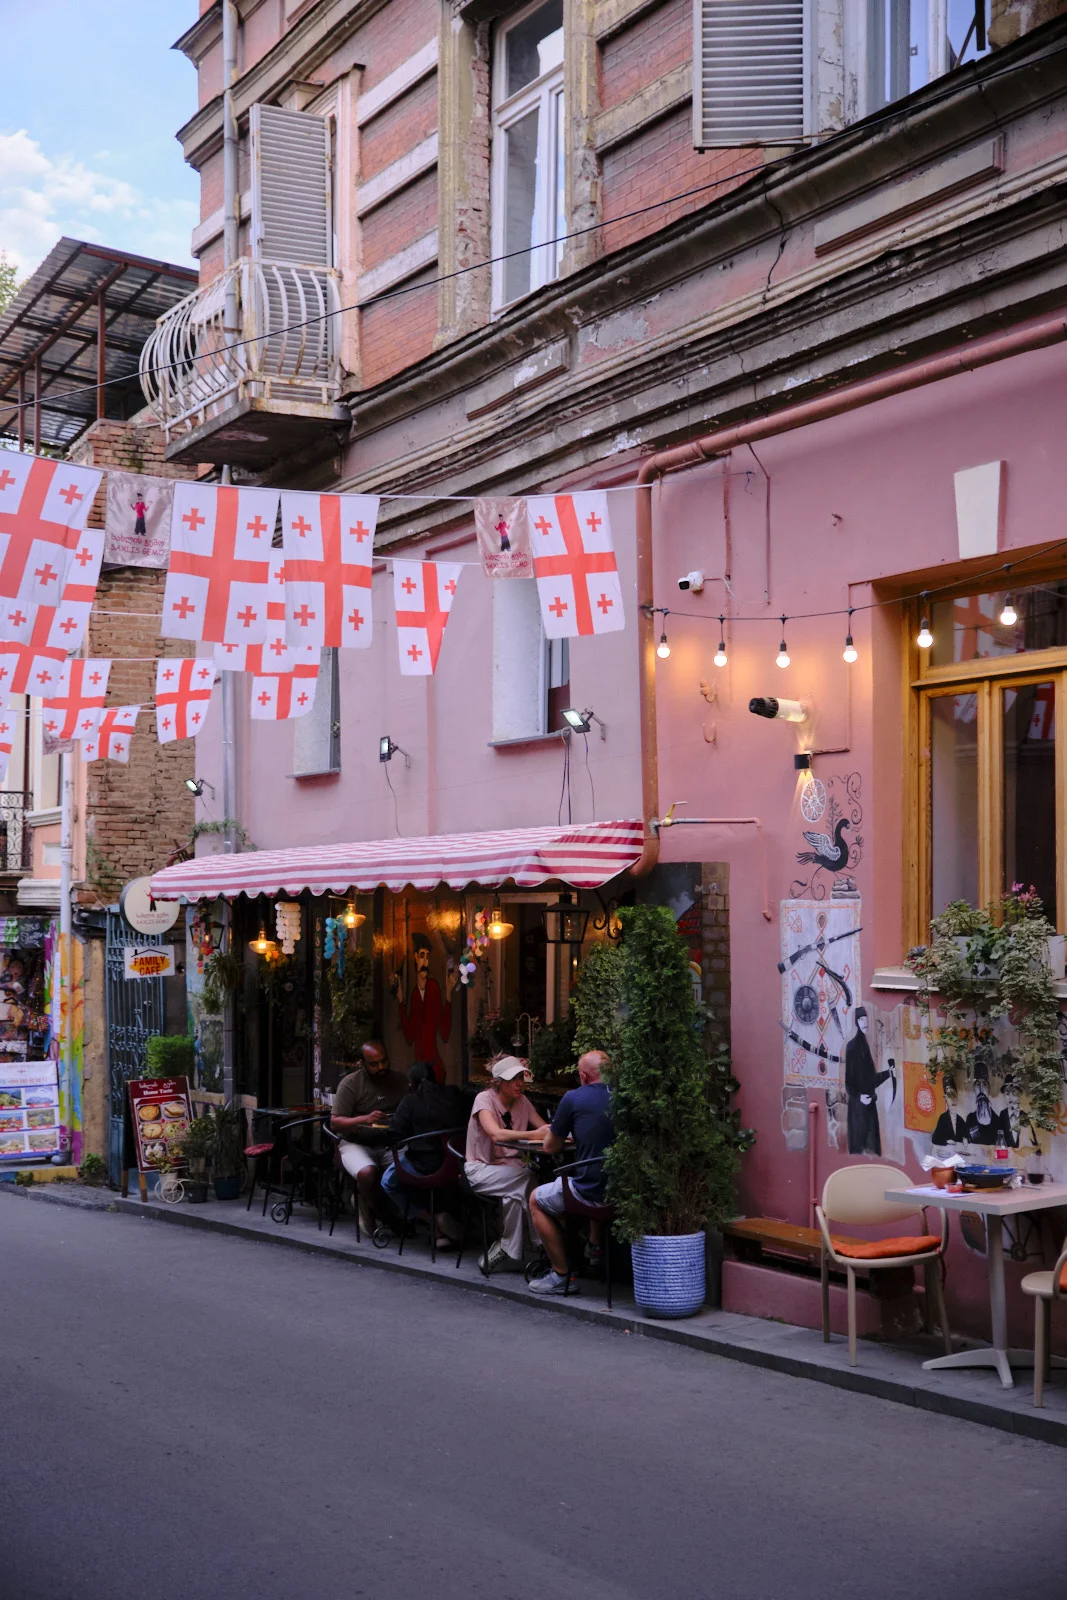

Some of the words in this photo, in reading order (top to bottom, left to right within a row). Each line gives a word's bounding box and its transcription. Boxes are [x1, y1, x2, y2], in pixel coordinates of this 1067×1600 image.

[111, 543, 140, 553] SAXLIS
[142, 547, 165, 556] GEMO
[134, 956, 166, 966] FAMILY
